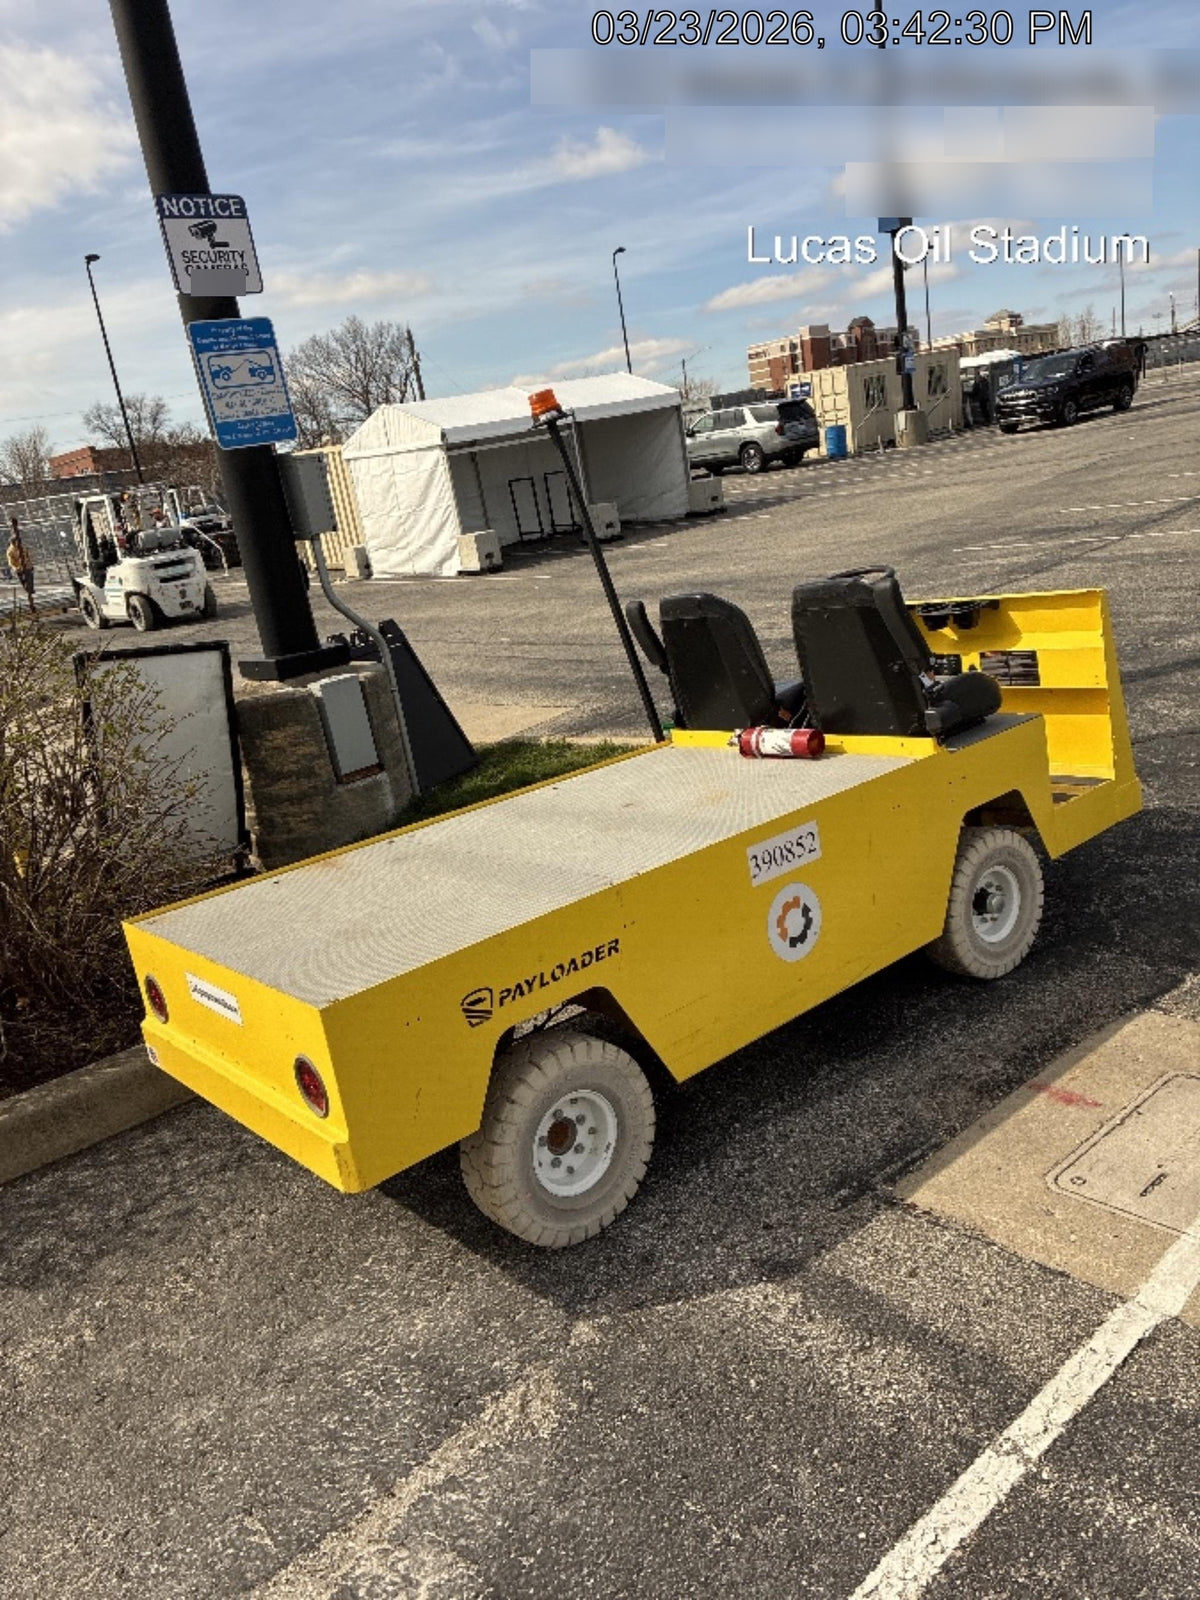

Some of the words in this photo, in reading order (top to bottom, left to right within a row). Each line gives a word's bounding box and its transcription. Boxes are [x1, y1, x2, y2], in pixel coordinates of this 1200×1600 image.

[161, 197, 244, 217] NOTICE
[181, 250, 245, 264] SECURITY
[749, 830, 818, 880] 390852
[498, 937, 621, 1009] PAYLOADER
